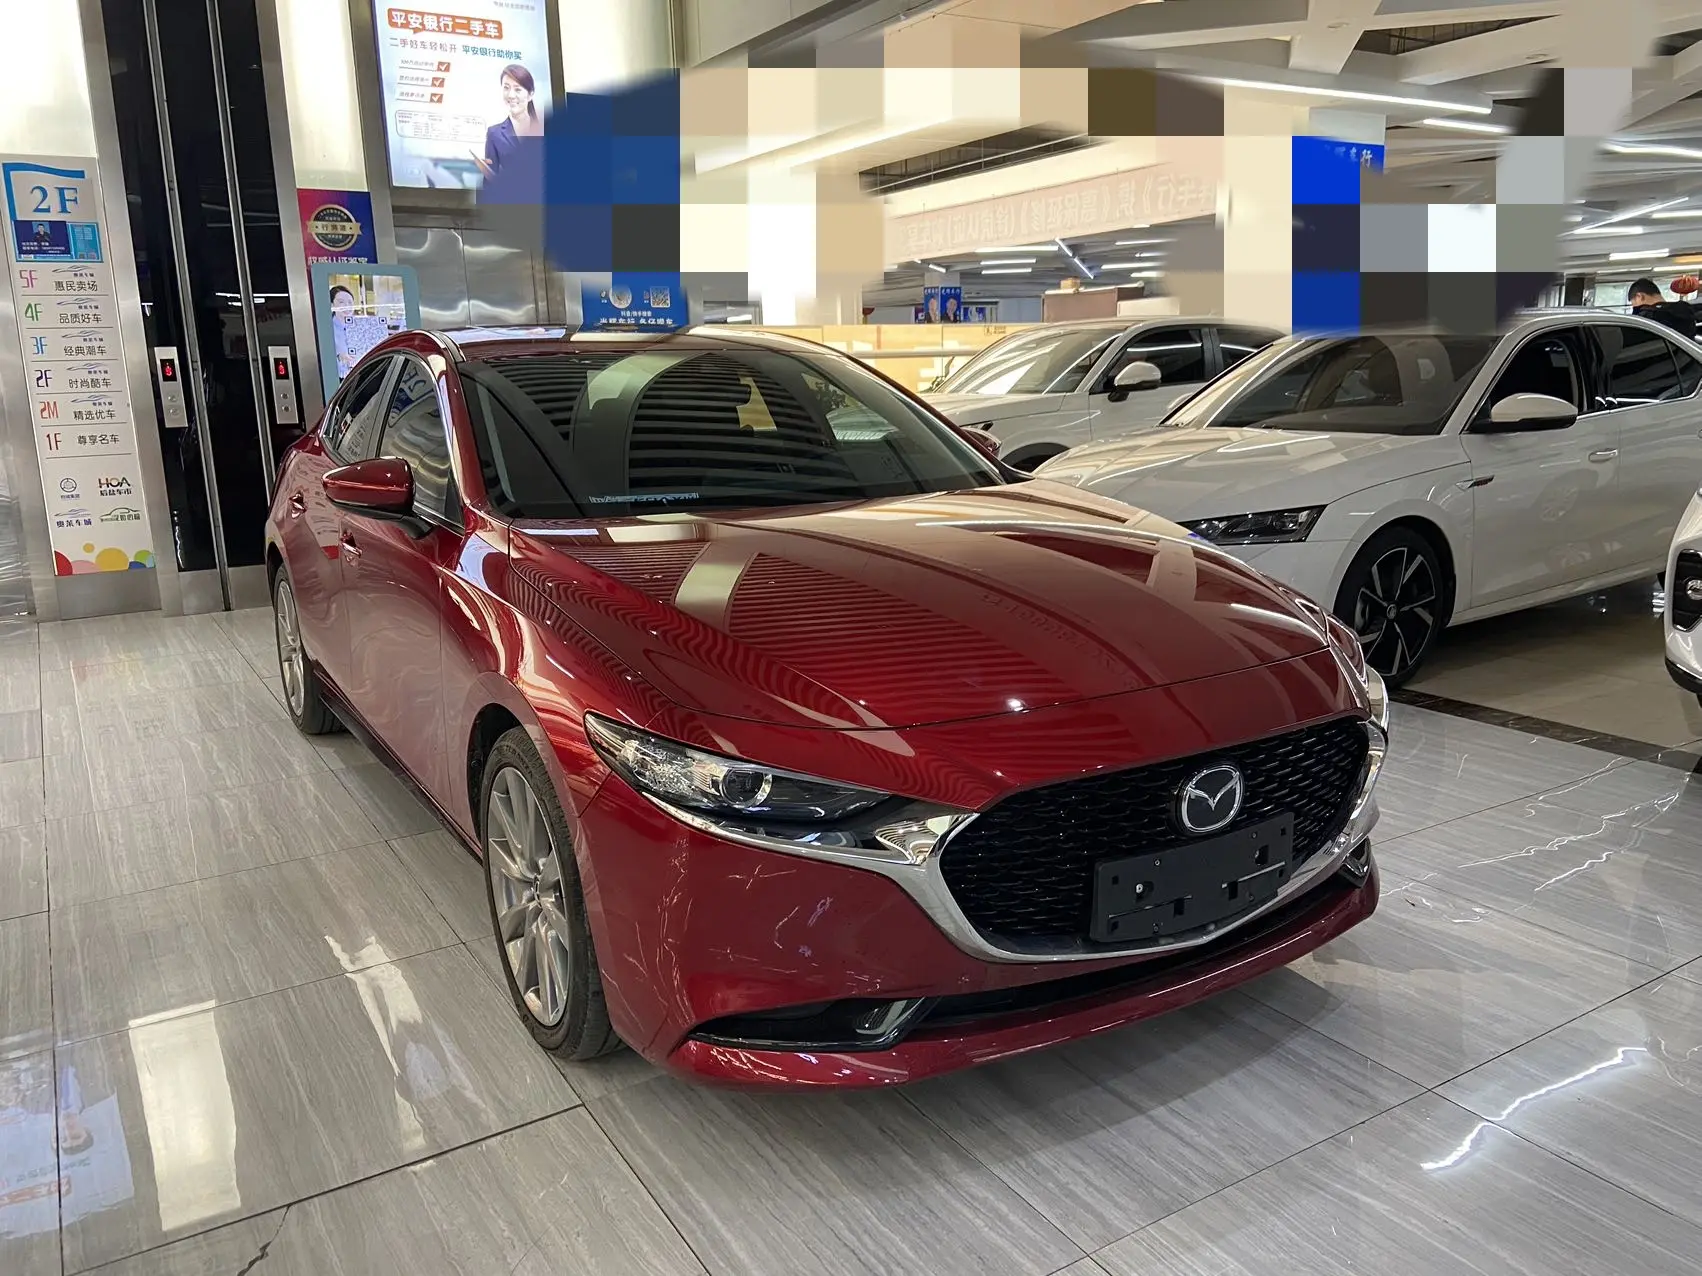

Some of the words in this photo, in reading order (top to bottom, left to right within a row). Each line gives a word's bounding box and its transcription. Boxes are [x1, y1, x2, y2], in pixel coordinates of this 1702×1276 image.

[391, 11, 499, 38] 平安银行二手车
[389, 37, 457, 54] 二手好车轻松开
[462, 45, 523, 61] 平安银行助你买
[30, 185, 79, 214] 2F
[20, 269, 39, 289] 5F
[54, 280, 98, 292] 惠民卖场
[24, 302, 43, 322] 4F
[59, 313, 102, 324] 品质好车
[30, 336, 48, 355] 3F
[63, 345, 107, 357] 经典潮车
[35, 369, 53, 388] 2F
[68, 377, 112, 389] 时尚酷车
[39, 401, 59, 420] 2M
[73, 409, 116, 421] 精选优车
[46, 432, 63, 451] 1F
[77, 433, 120, 445] 尊享名车
[98, 476, 131, 489] HOA
